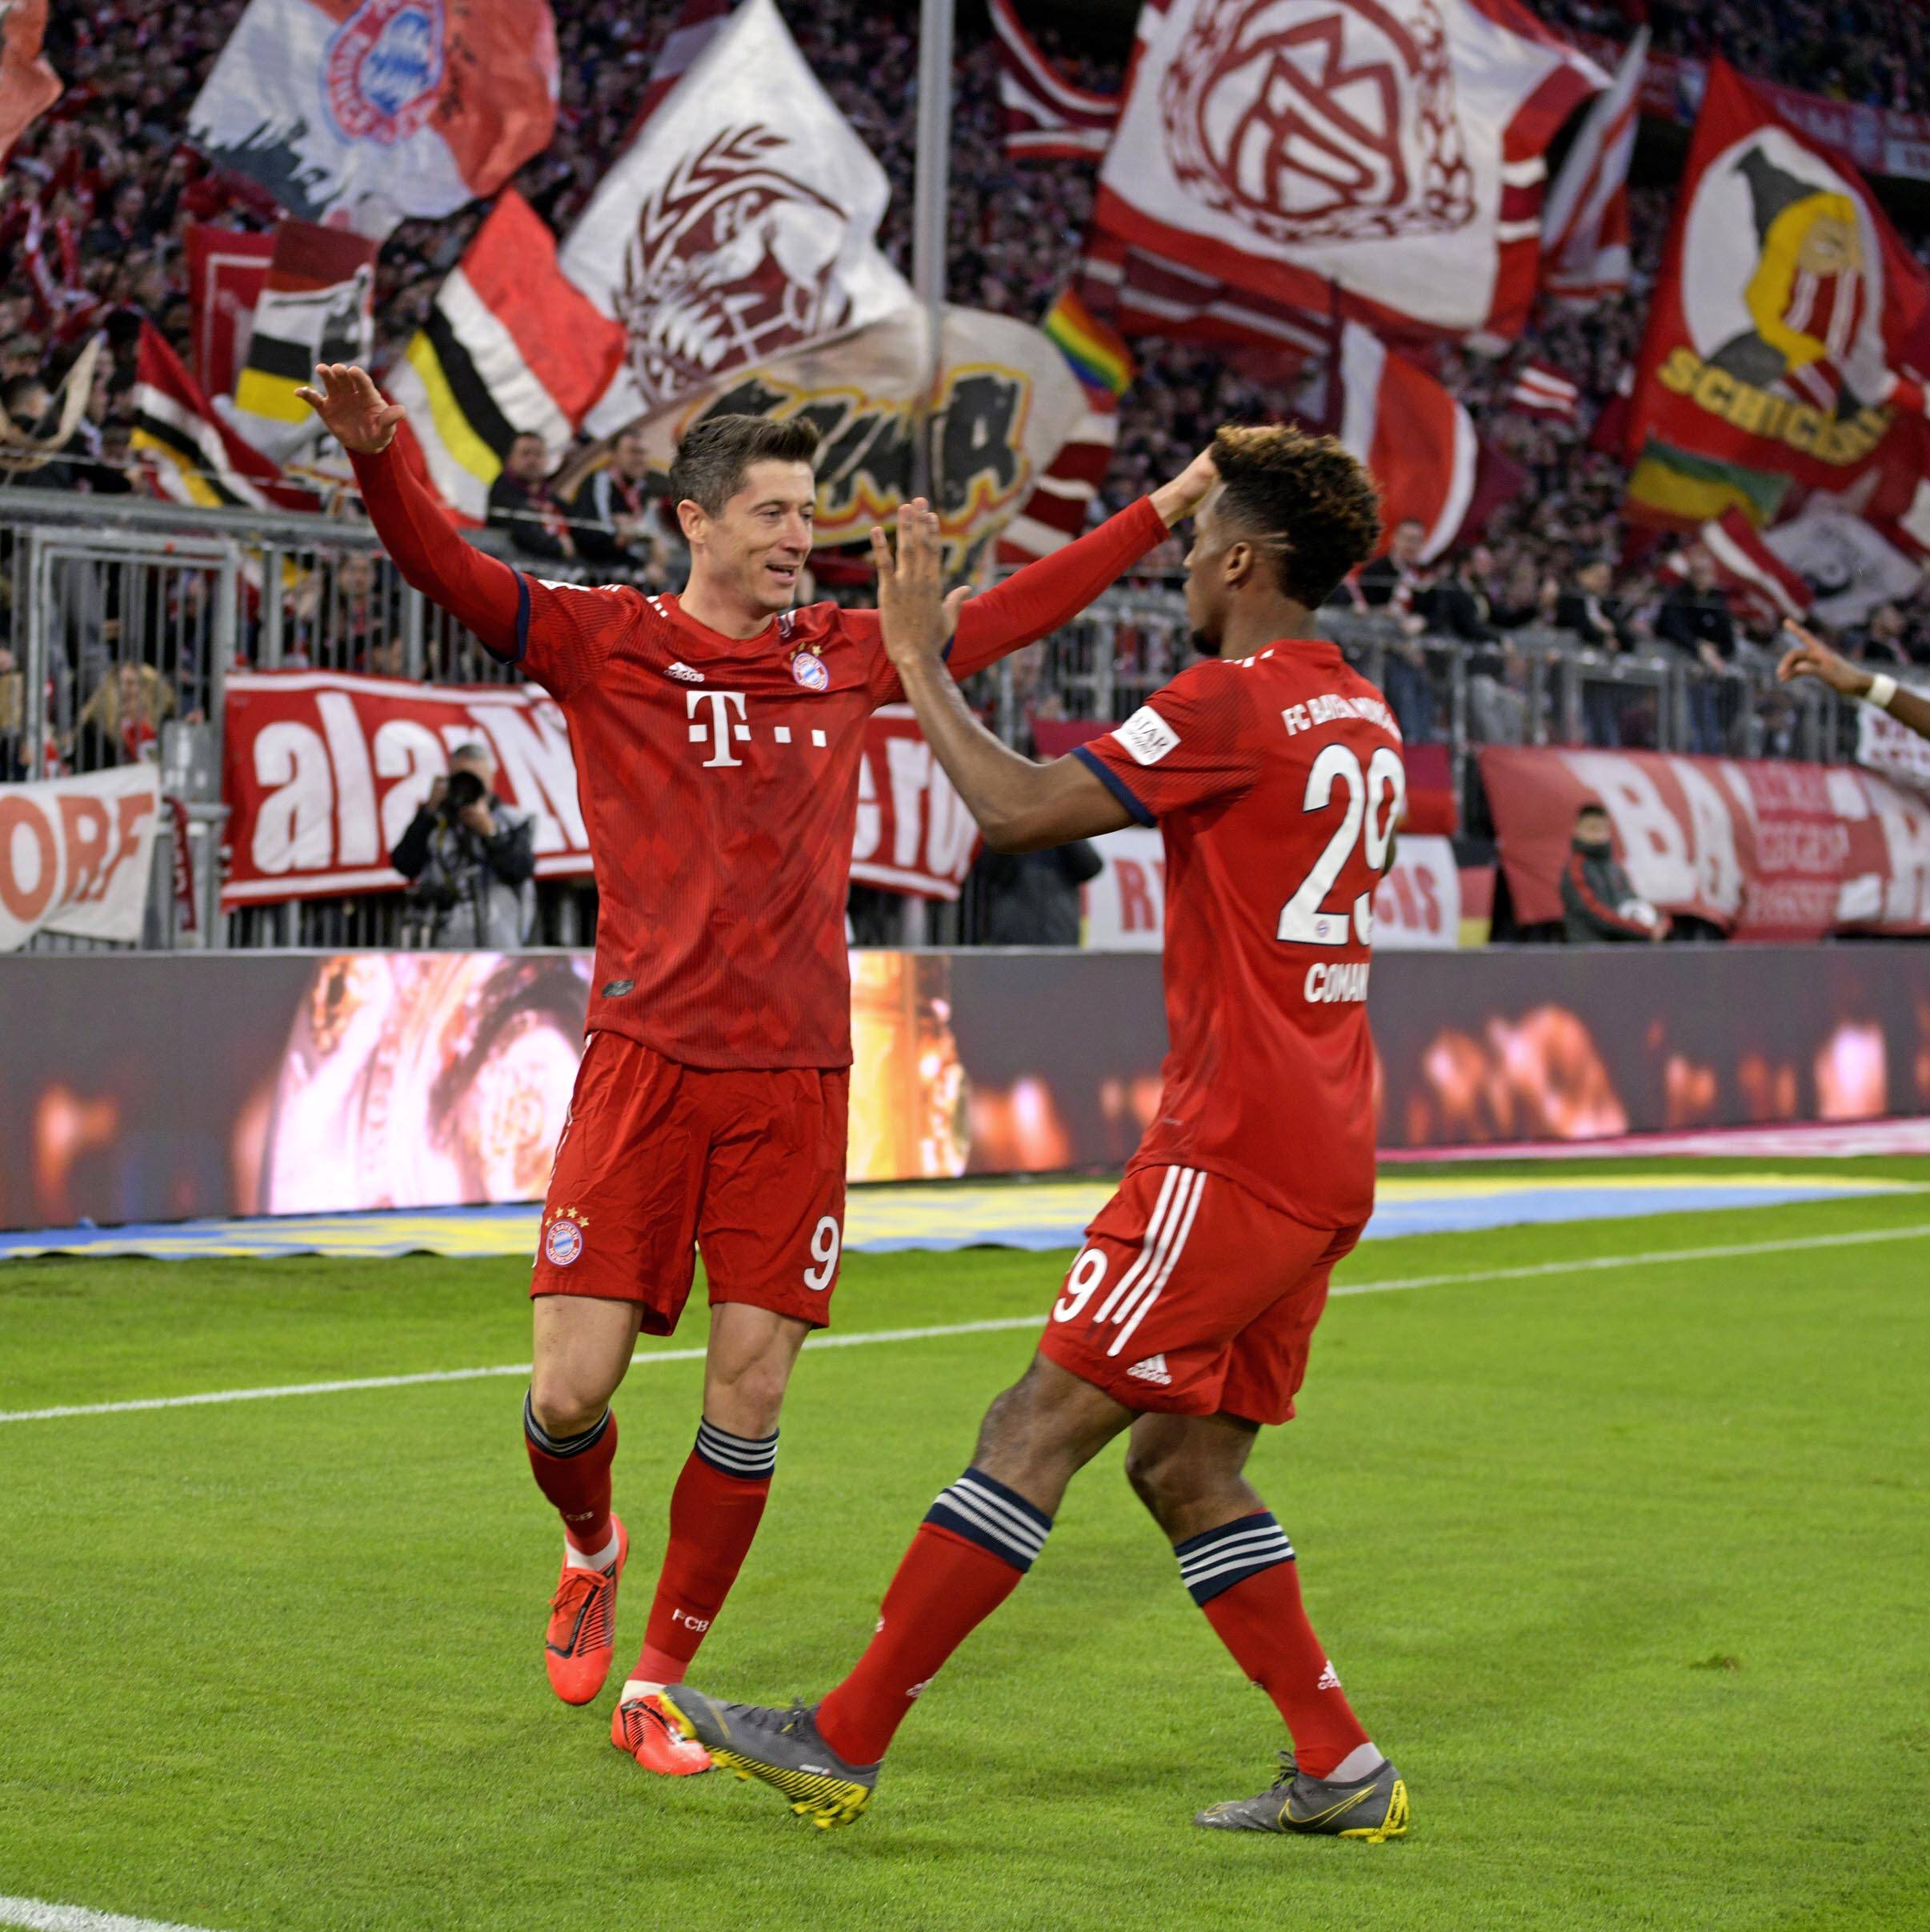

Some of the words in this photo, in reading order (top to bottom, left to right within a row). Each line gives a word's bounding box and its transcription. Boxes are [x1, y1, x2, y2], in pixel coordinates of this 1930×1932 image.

[1281, 704, 1311, 736] FC
[1276, 742, 1406, 946] 29
[803, 1215, 840, 1290] 9
[672, 1608, 710, 1632] FCB
